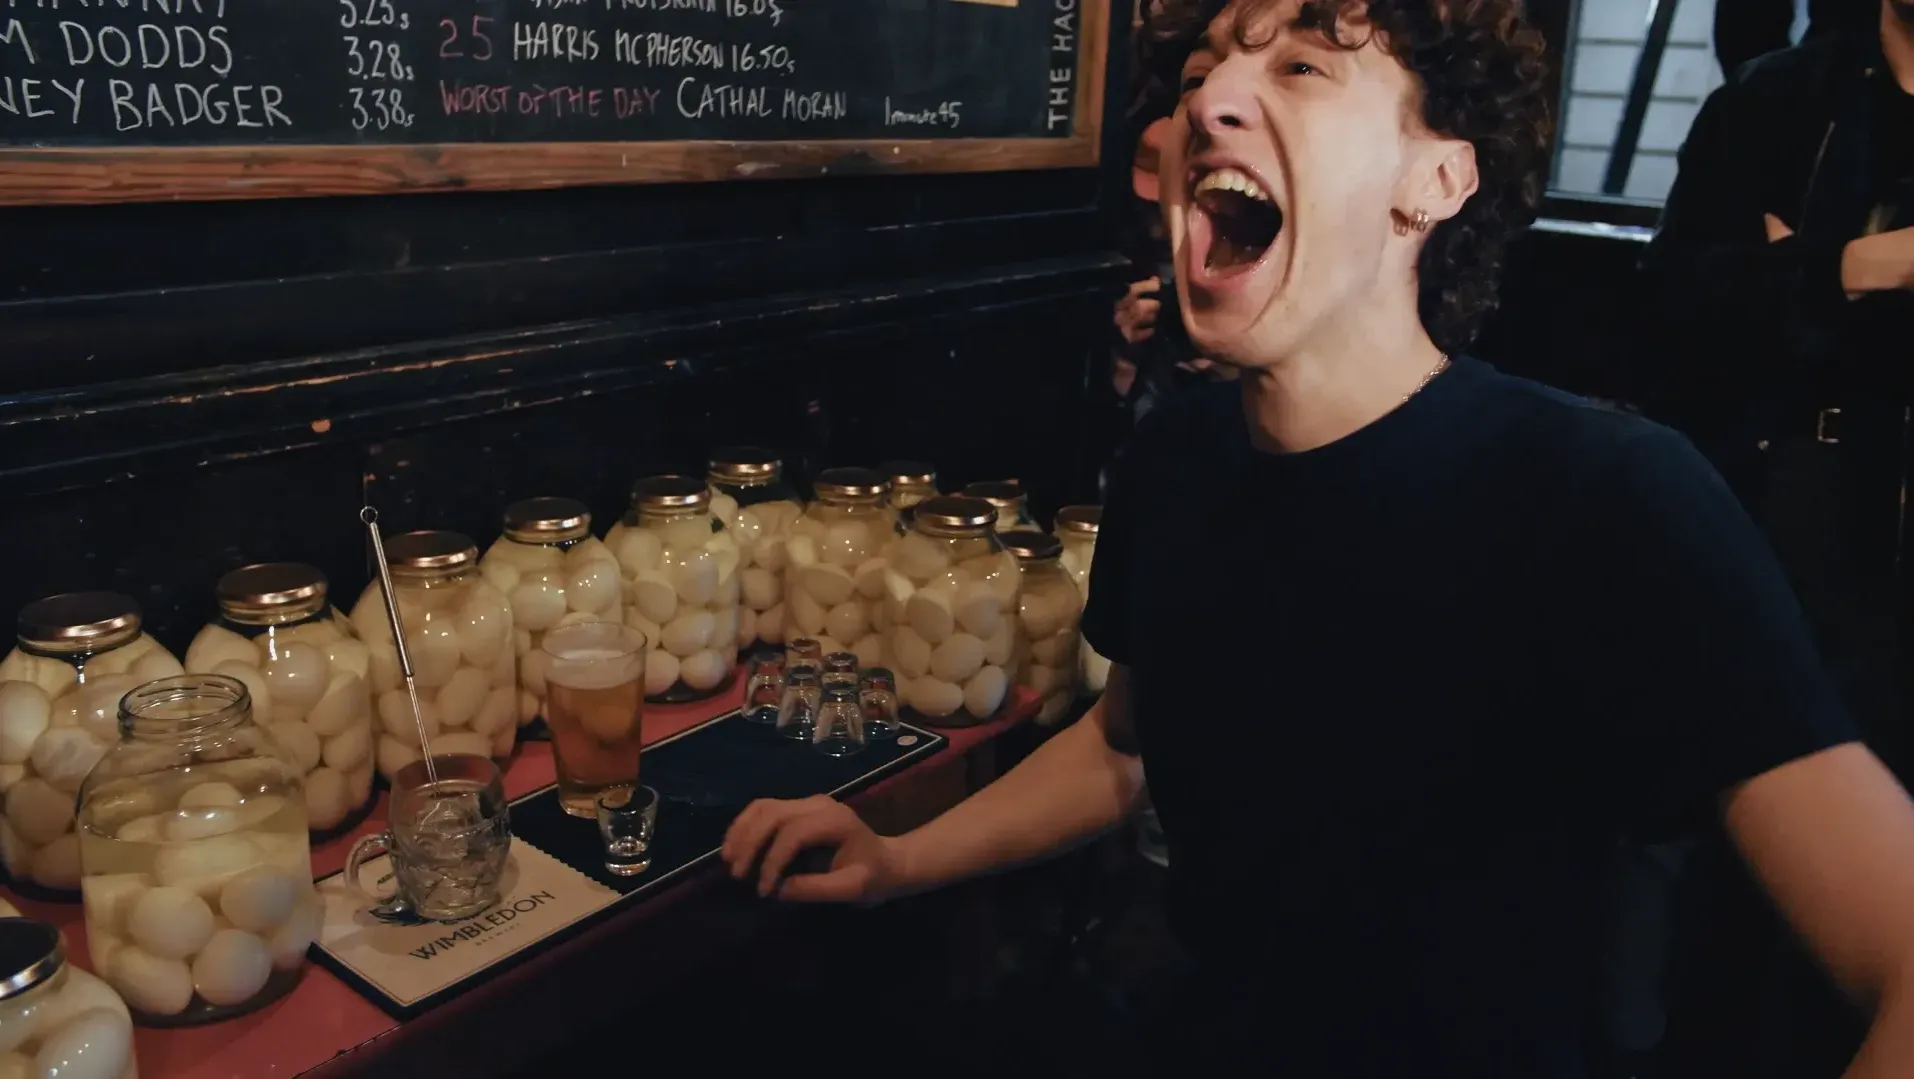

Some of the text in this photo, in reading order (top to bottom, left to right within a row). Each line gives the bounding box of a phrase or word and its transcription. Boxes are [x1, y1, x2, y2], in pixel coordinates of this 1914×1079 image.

[59, 20, 233, 76] DODDS
[343, 35, 414, 81] 3.28s
[513, 22, 600, 63] HARRIS
[109, 78, 292, 131] BADGER
[439, 79, 512, 116] WORST
[550, 85, 603, 118] THE
[613, 85, 661, 119] DAY
[677, 76, 772, 119] CATHAL
[782, 88, 847, 121] MORAN
[1047, 67, 1072, 130] THE
[408, 890, 556, 961] WIMBLEDON
